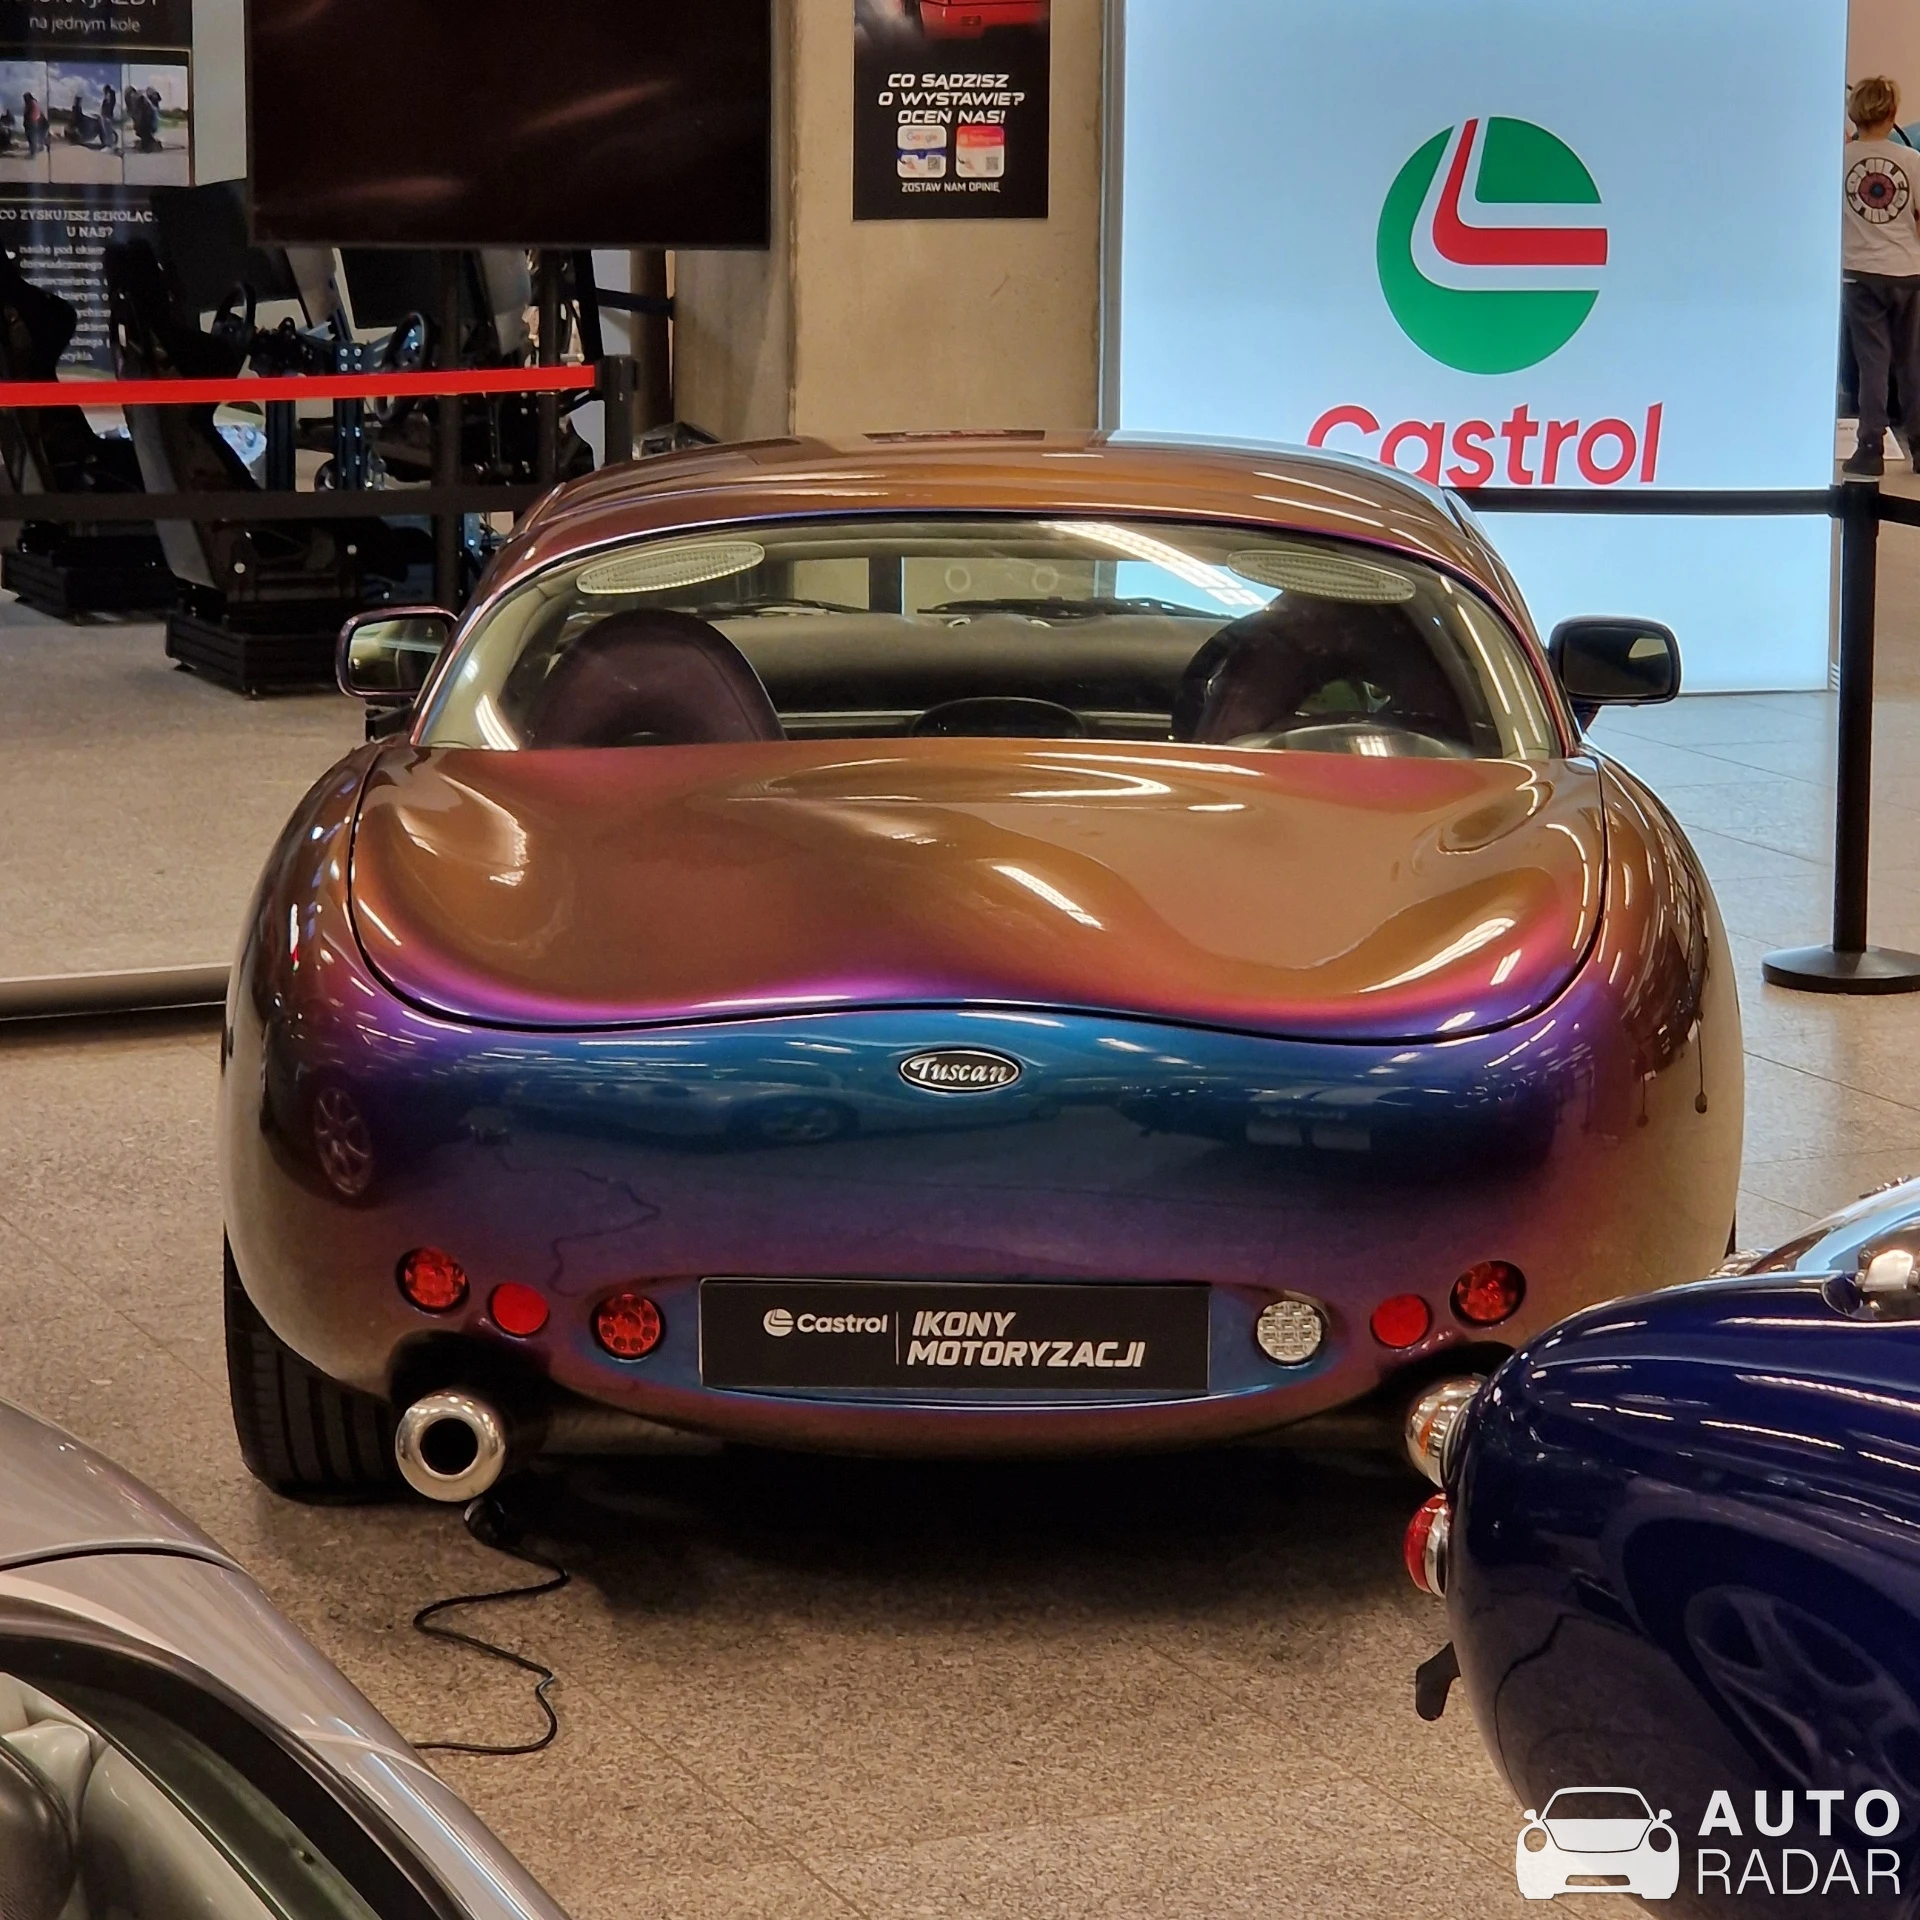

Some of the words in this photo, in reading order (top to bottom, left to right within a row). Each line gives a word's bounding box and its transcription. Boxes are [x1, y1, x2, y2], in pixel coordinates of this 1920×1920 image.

[29, 17, 48, 29] na
[51, 16, 106, 35] jednym
[110, 17, 141, 32] kole
[887, 73, 916, 88] CO
[921, 73, 1010, 90] SĄDZISZ
[878, 92, 893, 106] O
[901, 92, 1025, 106] WYSTAWIE?
[897, 107, 952, 124] OCEŃ
[957, 110, 1006, 124] NAS!
[906, 131, 938, 146] Google
[901, 182, 941, 193] ZOSTAW
[944, 182, 966, 193] NAM
[0, 210, 17, 221] CO
[20, 210, 90, 222] ZYSKUJESZ
[66, 226, 76, 237] U
[79, 226, 113, 238] NAS?
[1306, 402, 1663, 487] Castrol
[909, 1056, 1008, 1083] Tuscan
[796, 1312, 888, 1334] Castrol
[912, 1310, 1017, 1338] IKONY
[907, 1340, 1146, 1368] MOTORYZACJI
